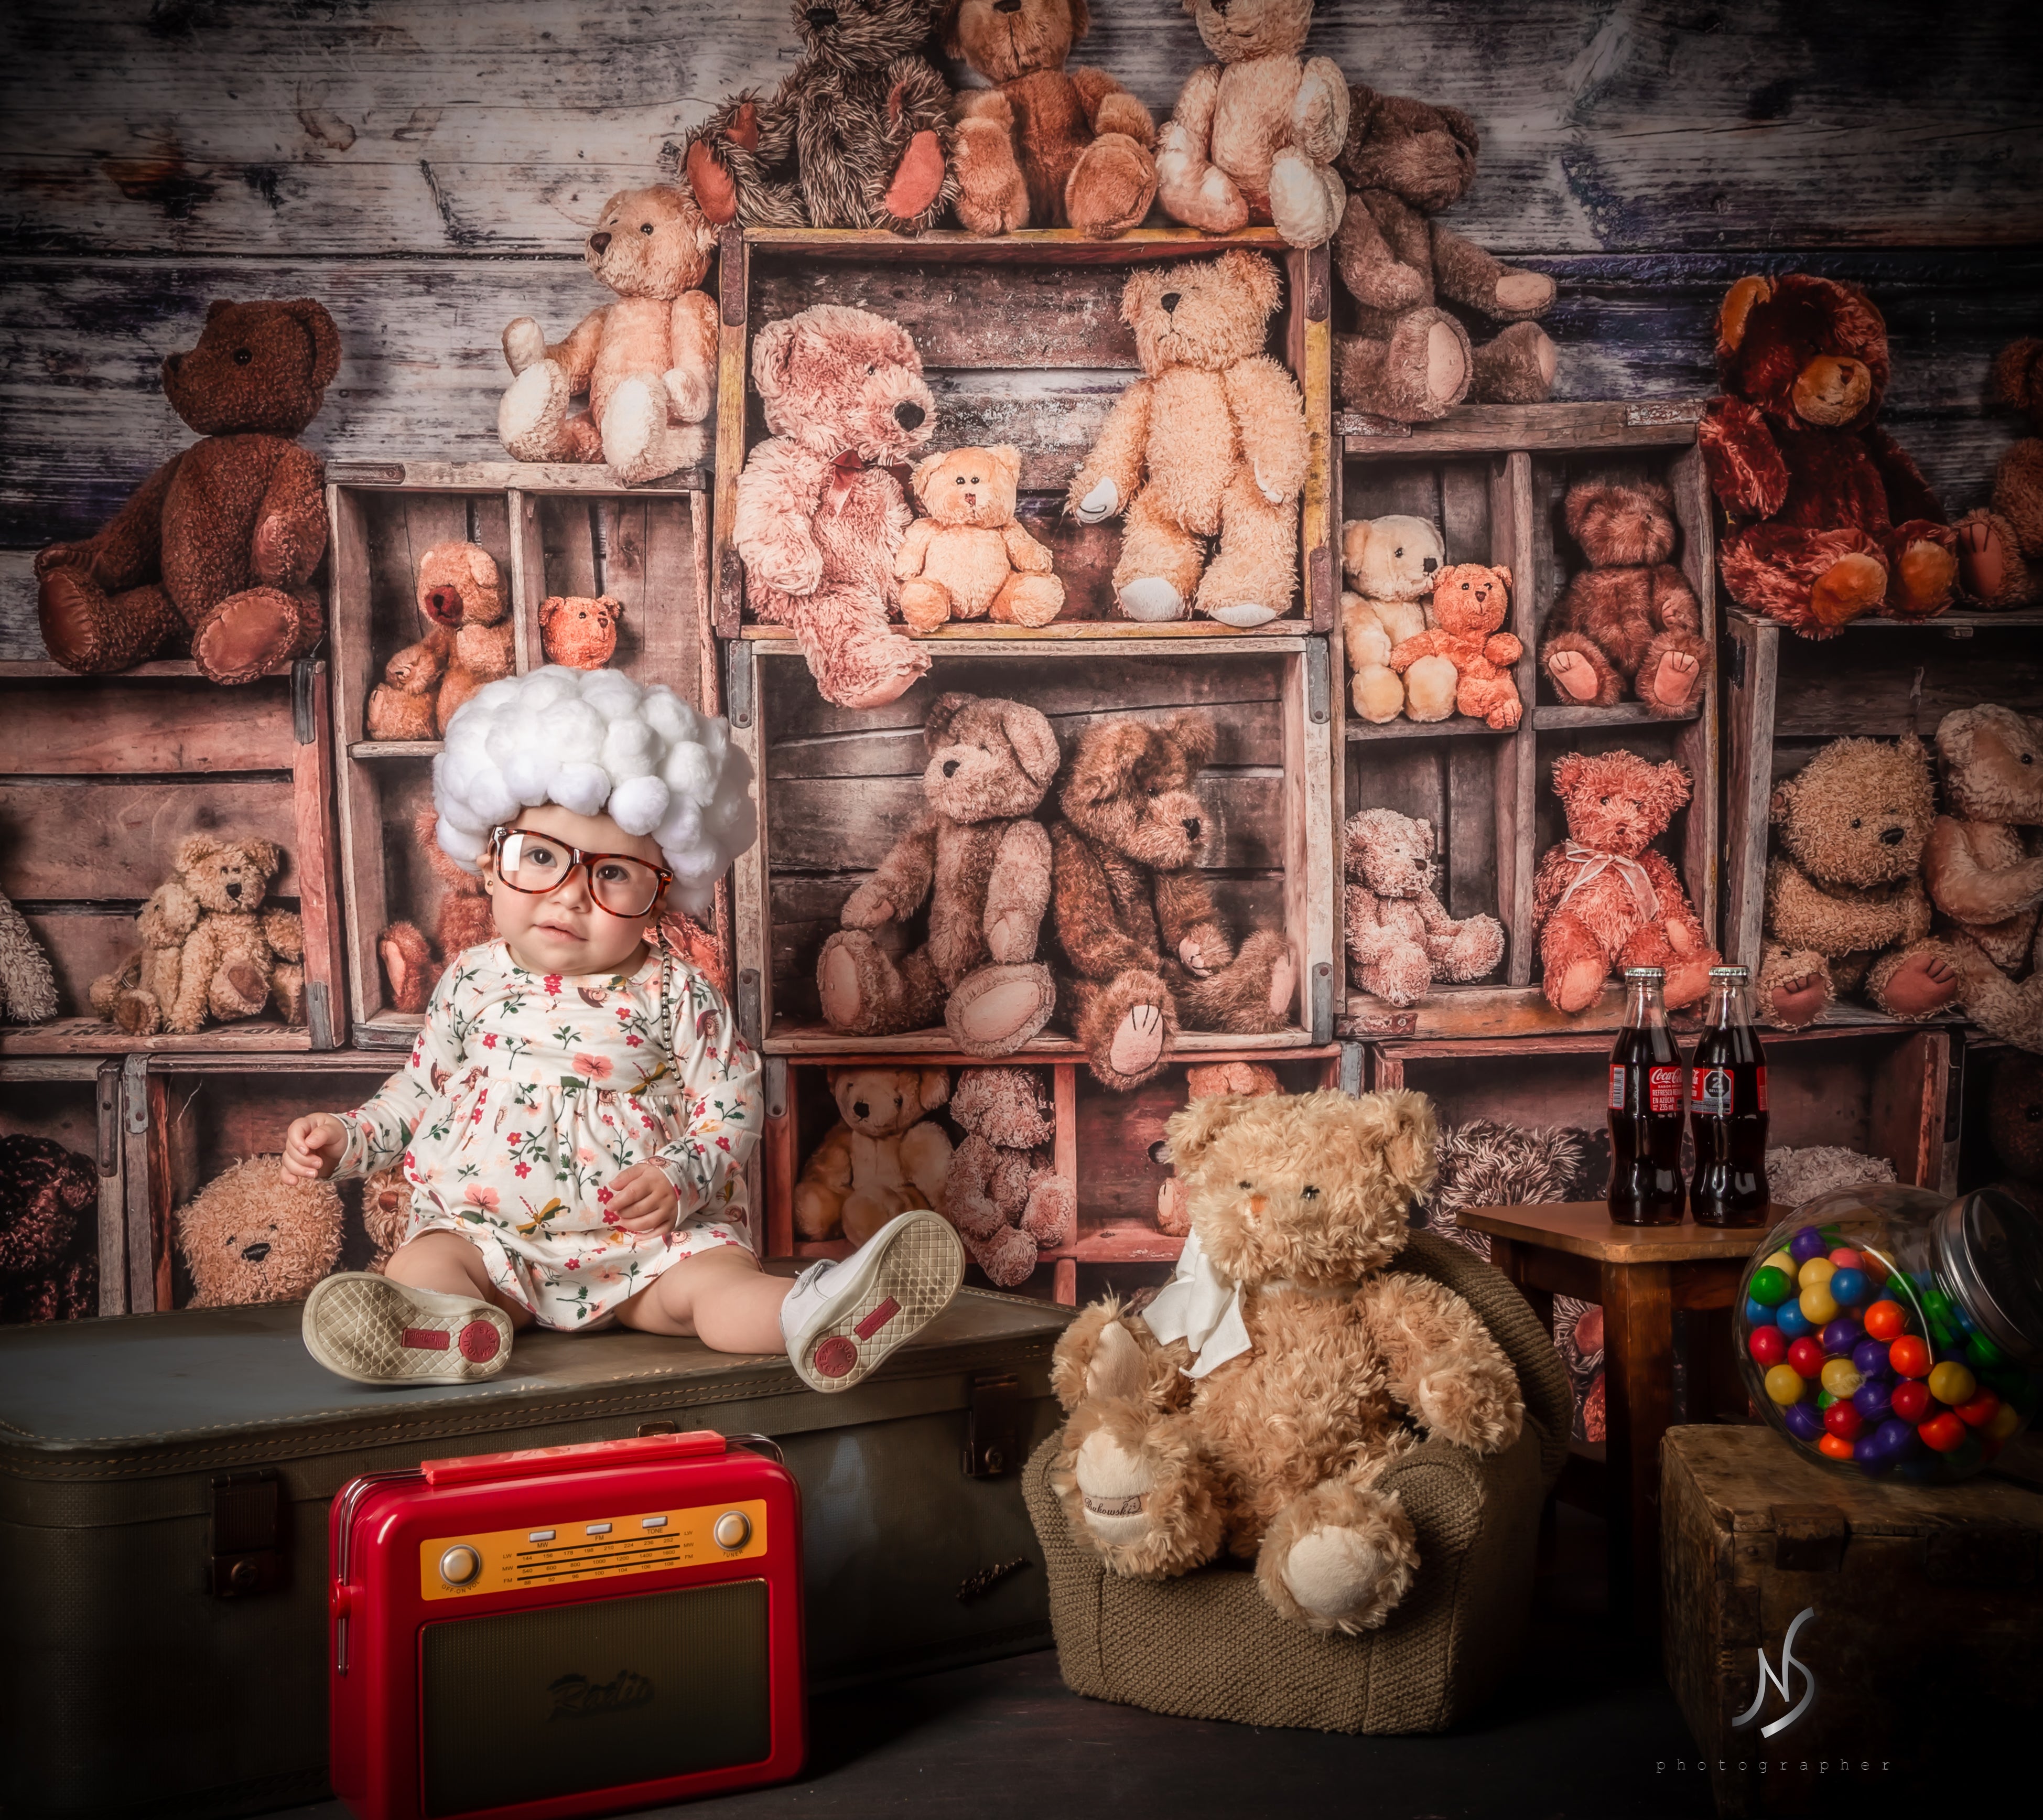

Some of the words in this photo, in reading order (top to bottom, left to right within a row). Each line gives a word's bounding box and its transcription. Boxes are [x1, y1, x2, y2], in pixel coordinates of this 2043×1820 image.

[1712, 1077, 1722, 1089] 2
[1084, 1498, 1132, 1515] Bukowski
[722, 1549, 743, 1558] TUNER
[441, 1584, 466, 1594] OFF-ON
[467, 1580, 480, 1590] VOL
[547, 1670, 655, 1719] Radio
